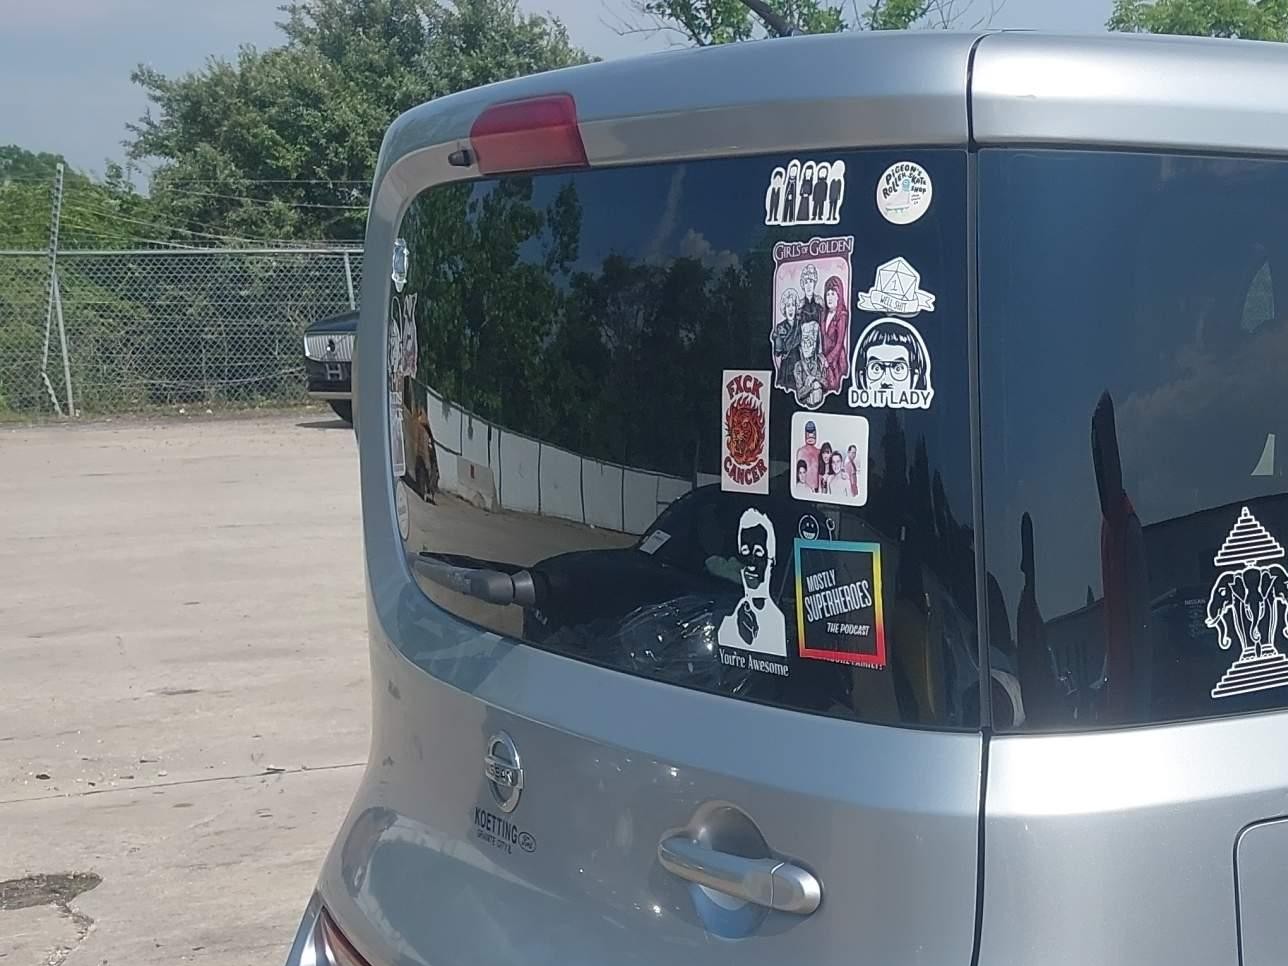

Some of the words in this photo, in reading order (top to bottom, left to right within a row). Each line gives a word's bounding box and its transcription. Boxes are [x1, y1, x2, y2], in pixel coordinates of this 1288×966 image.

[775, 244, 801, 260] GIRLS
[809, 239, 851, 256] GOLDEN
[891, 280, 898, 291] 1
[880, 294, 893, 307] WELL
[893, 298, 907, 313] SHIT
[851, 390, 869, 404] DO
[873, 390, 887, 403] IT
[890, 391, 931, 405] LADY
[724, 455, 767, 485] CANCER
[806, 569, 836, 593] MOSTLY
[804, 580, 872, 622] SUPERHEROES
[827, 622, 839, 634] THE
[839, 623, 870, 636] PODCAST
[719, 648, 746, 667] You're
[748, 656, 790, 677] Awesome
[474, 807, 518, 844] KOETTING
